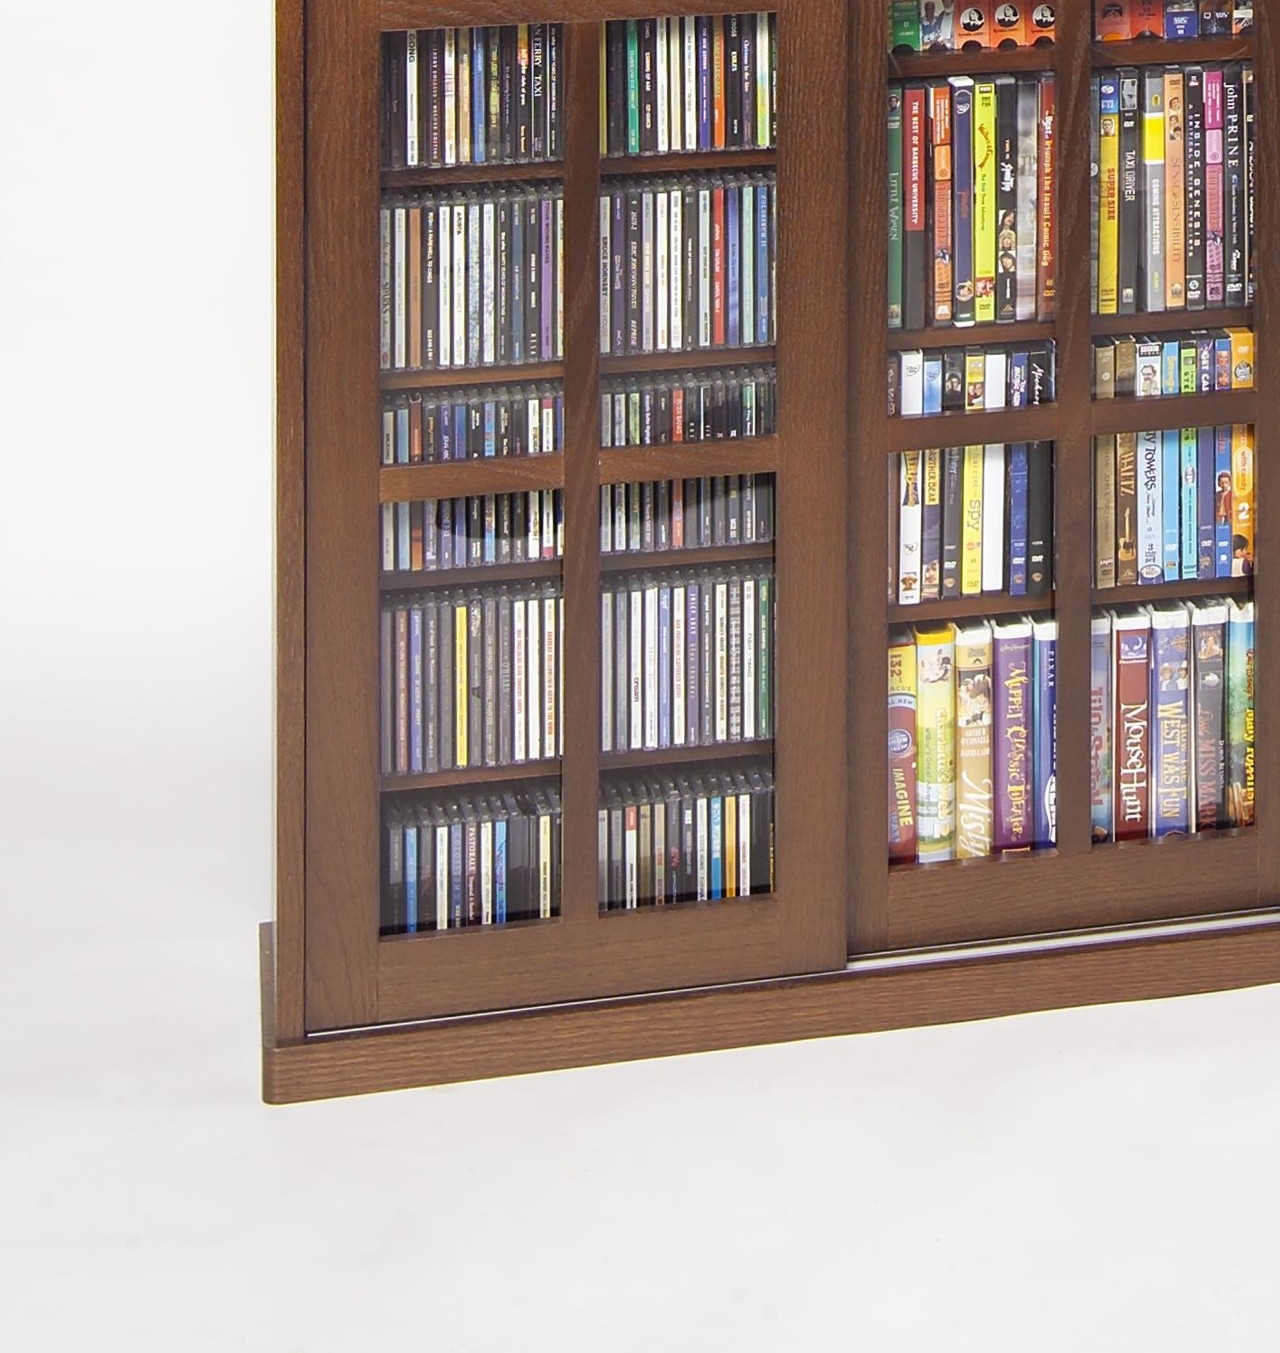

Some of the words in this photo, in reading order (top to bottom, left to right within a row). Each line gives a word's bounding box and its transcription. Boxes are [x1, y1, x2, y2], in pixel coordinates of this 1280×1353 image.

[534, 38, 542, 67] FERRY
[534, 74, 542, 97] TAXI
[1224, 83, 1239, 109] john
[1228, 114, 1239, 168] PRINE
[889, 172, 898, 202] LITTLE
[1107, 168, 1116, 198] SUPER
[1124, 171, 1135, 202] DRIVER
[1152, 179, 1160, 206] COMING
[1043, 193, 1052, 219] Insult
[1043, 221, 1052, 248] Comic
[1152, 208, 1160, 255] ATTRACTIONS
[1120, 452, 1135, 496] WALTZ
[1144, 447, 1157, 491] TOWERS
[967, 500, 981, 532] spy
[1004, 662, 1028, 721] MUPPET
[1157, 701, 1186, 747] WEST
[1120, 700, 1148, 822] MouseHunt
[1162, 752, 1178, 783] WAS
[894, 769, 913, 827] IMAGINE
[958, 771, 992, 856] Misty
